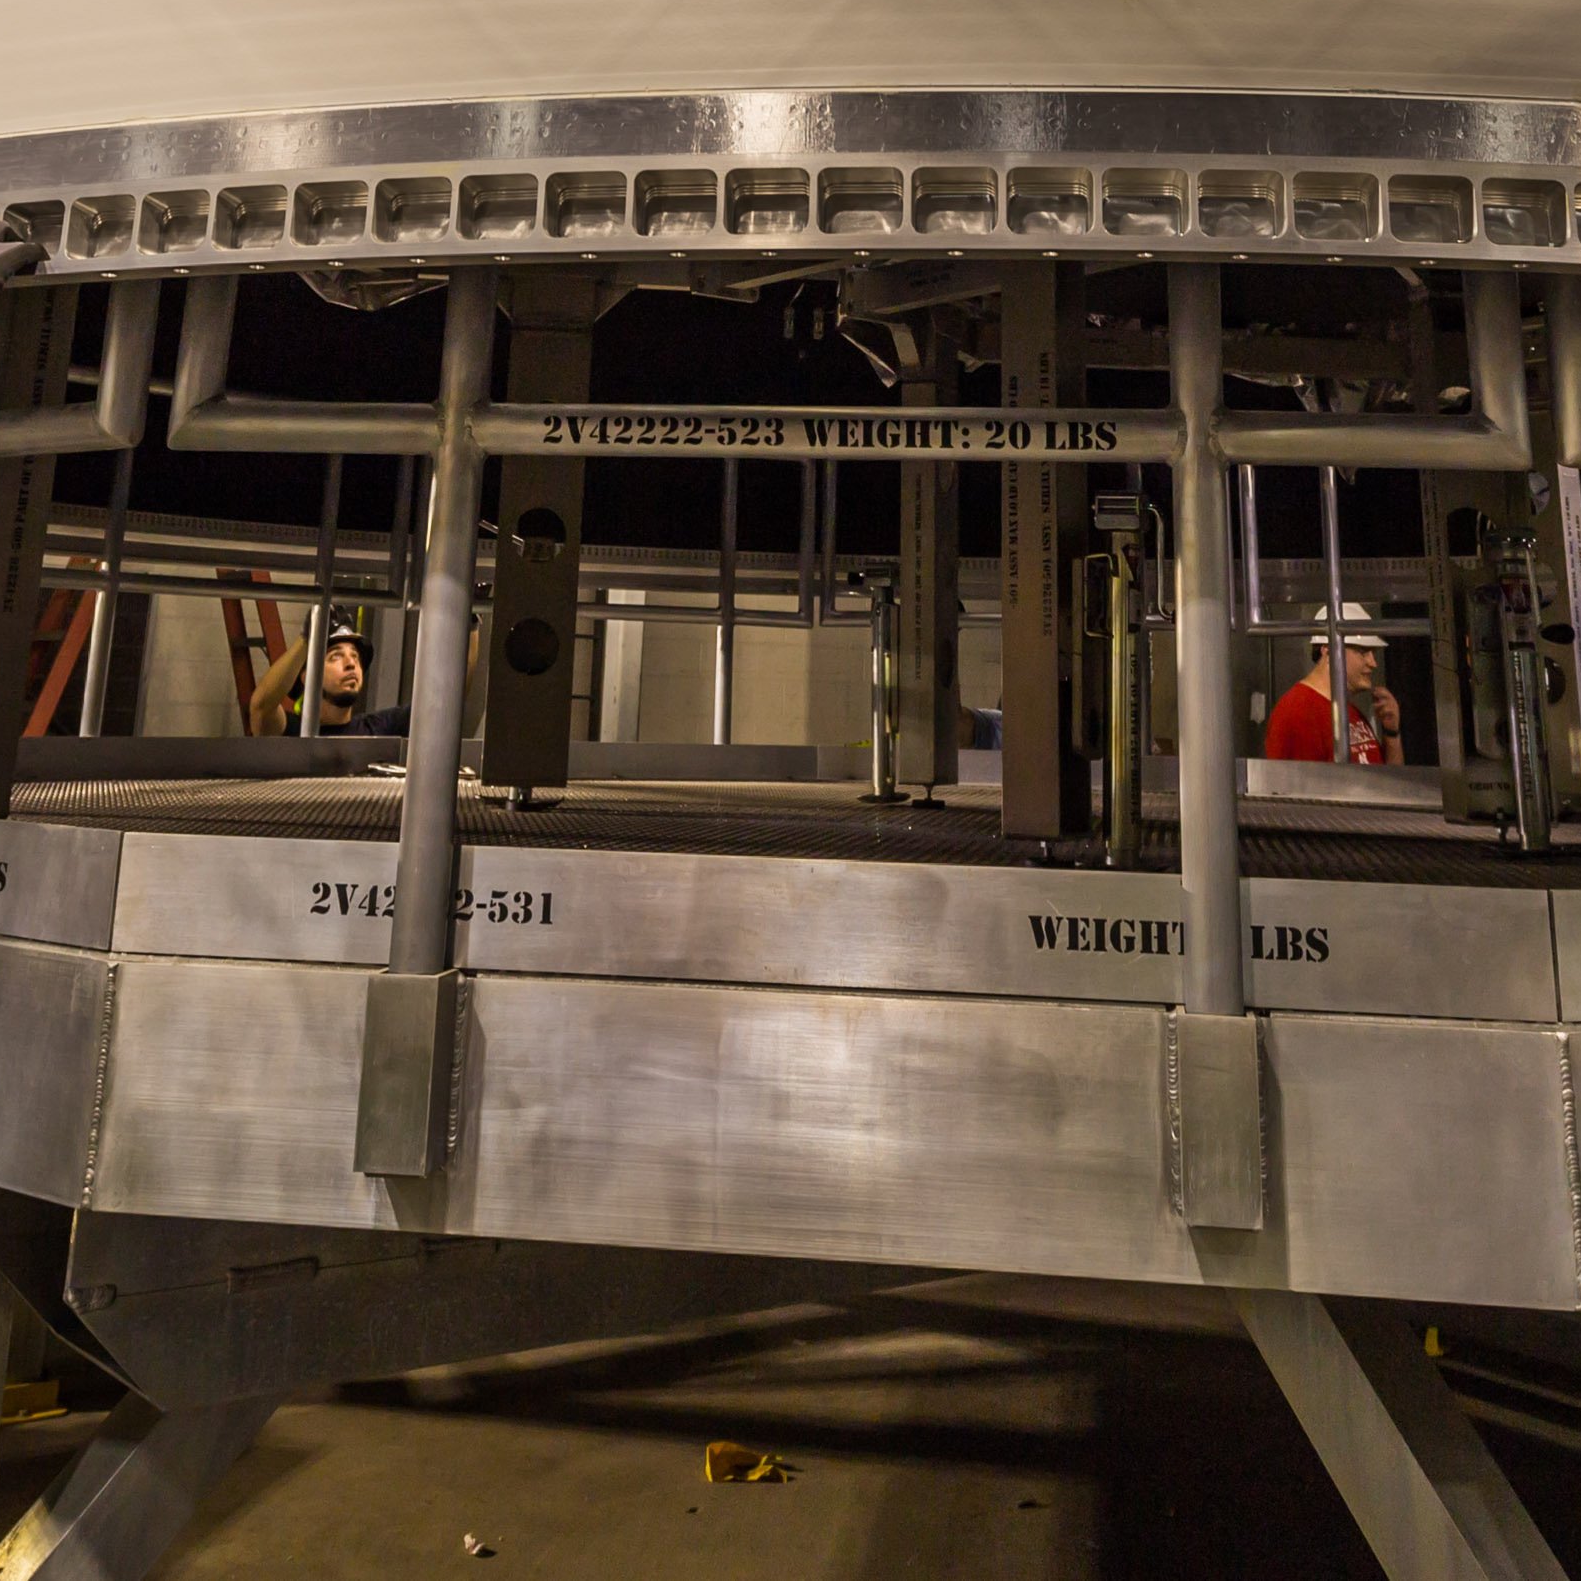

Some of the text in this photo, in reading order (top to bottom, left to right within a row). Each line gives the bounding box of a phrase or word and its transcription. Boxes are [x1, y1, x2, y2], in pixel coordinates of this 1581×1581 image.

[543, 415, 1118, 452] 2V42222-523 WEIGHT: 20 LBS
[1009, 520, 1019, 545] MAX
[1009, 551, 1019, 579] ASSY
[310, 881, 554, 926] 2V422-531
[1250, 925, 1330, 963] LBS
